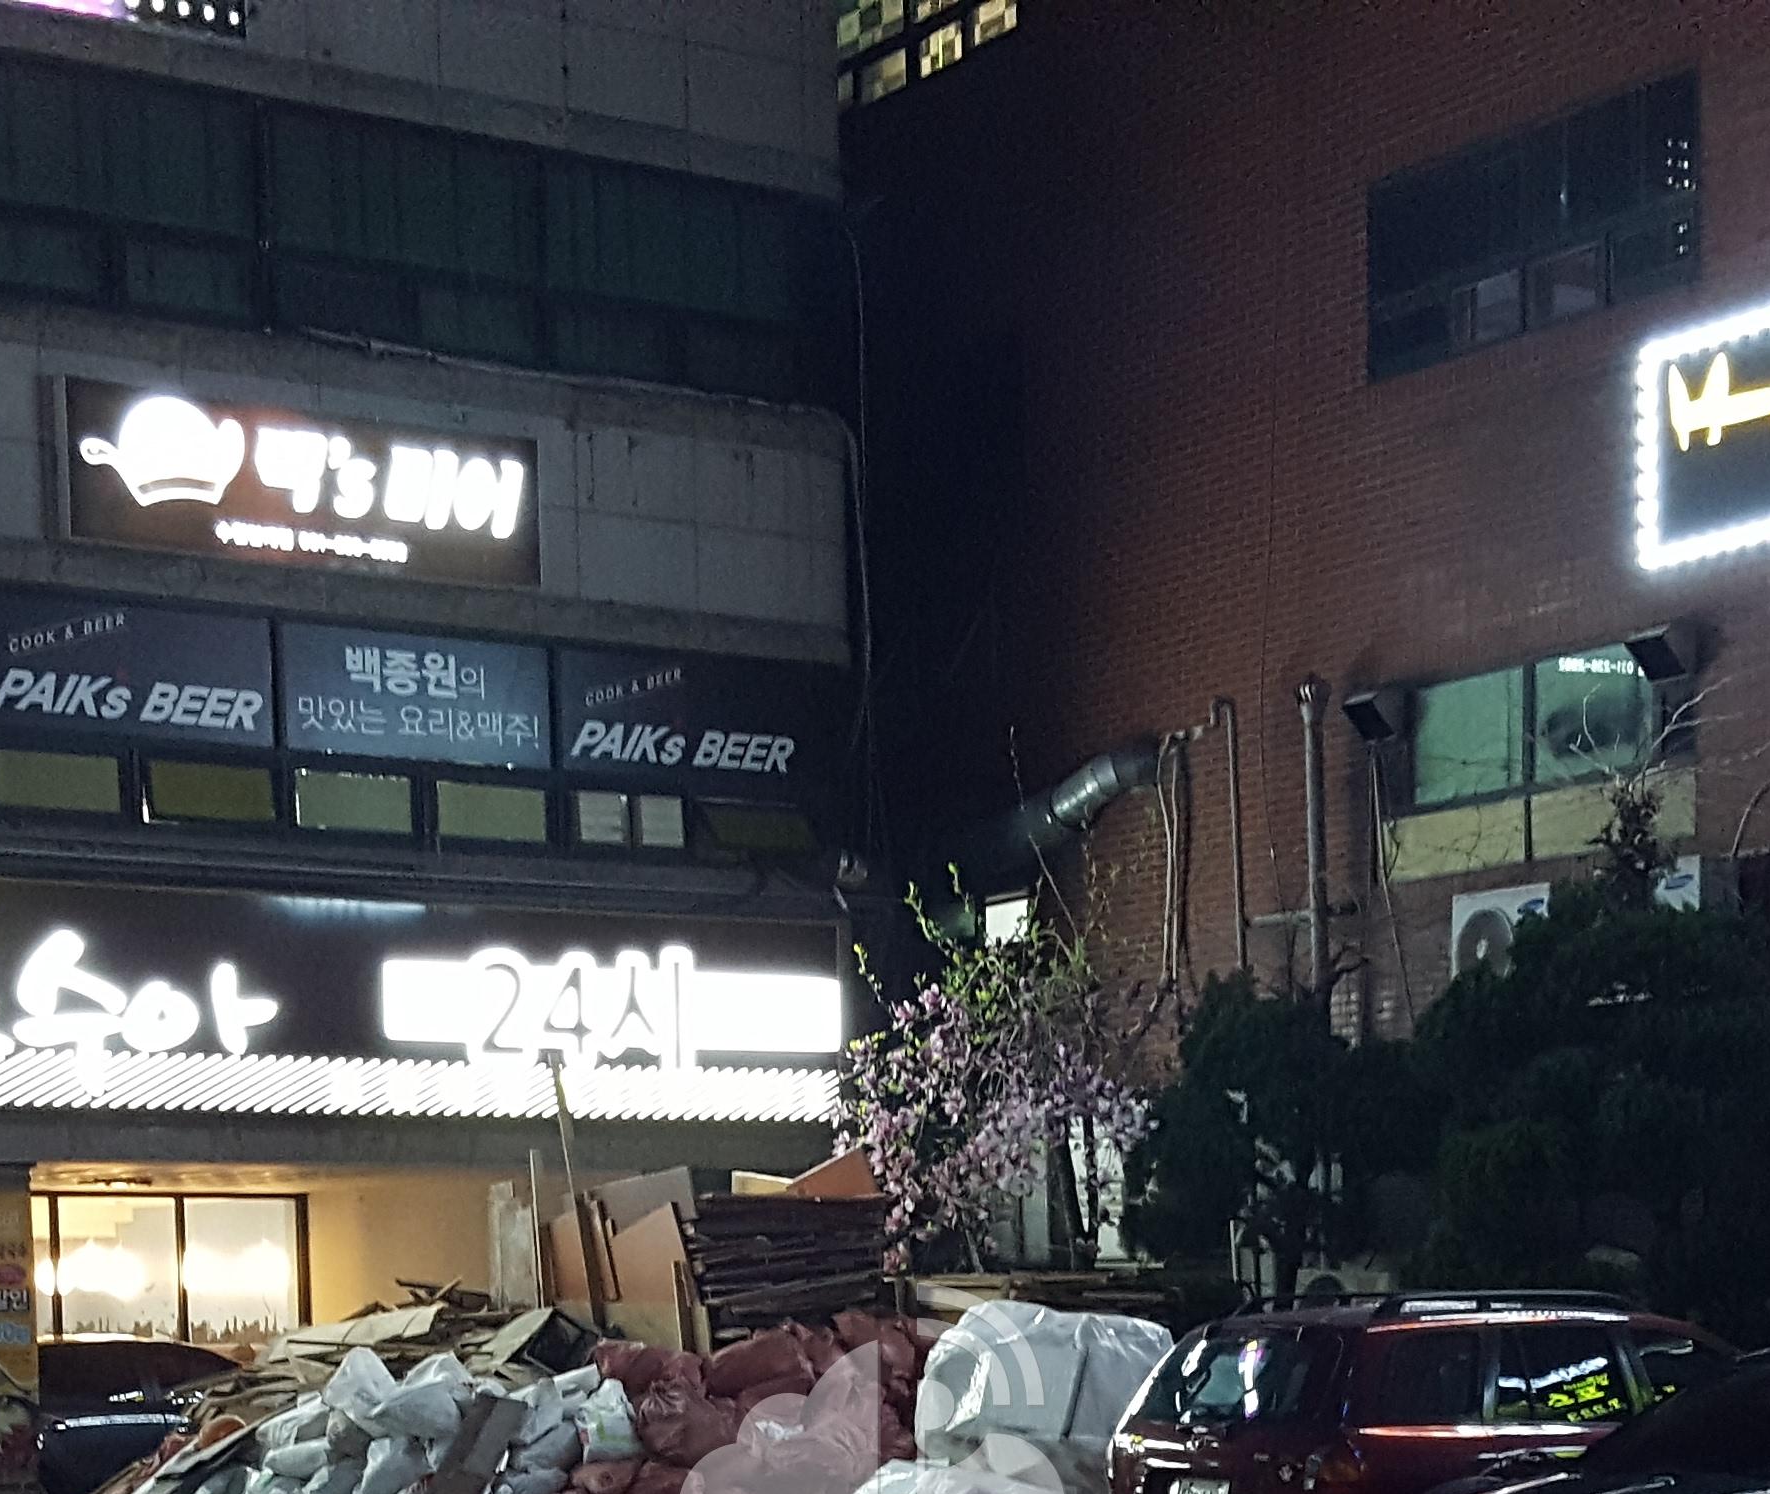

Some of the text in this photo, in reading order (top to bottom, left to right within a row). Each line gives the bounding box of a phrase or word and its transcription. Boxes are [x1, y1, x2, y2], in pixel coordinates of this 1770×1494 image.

[9, 629, 56, 653] COOK
[84, 613, 125, 635] BEER
[345, 646, 485, 700] 백종원의
[139, 681, 263, 731] BEER
[297, 696, 387, 734] 맛있는
[571, 719, 795, 773] PAIKs BEER
[475, 952, 689, 1070] 24시
